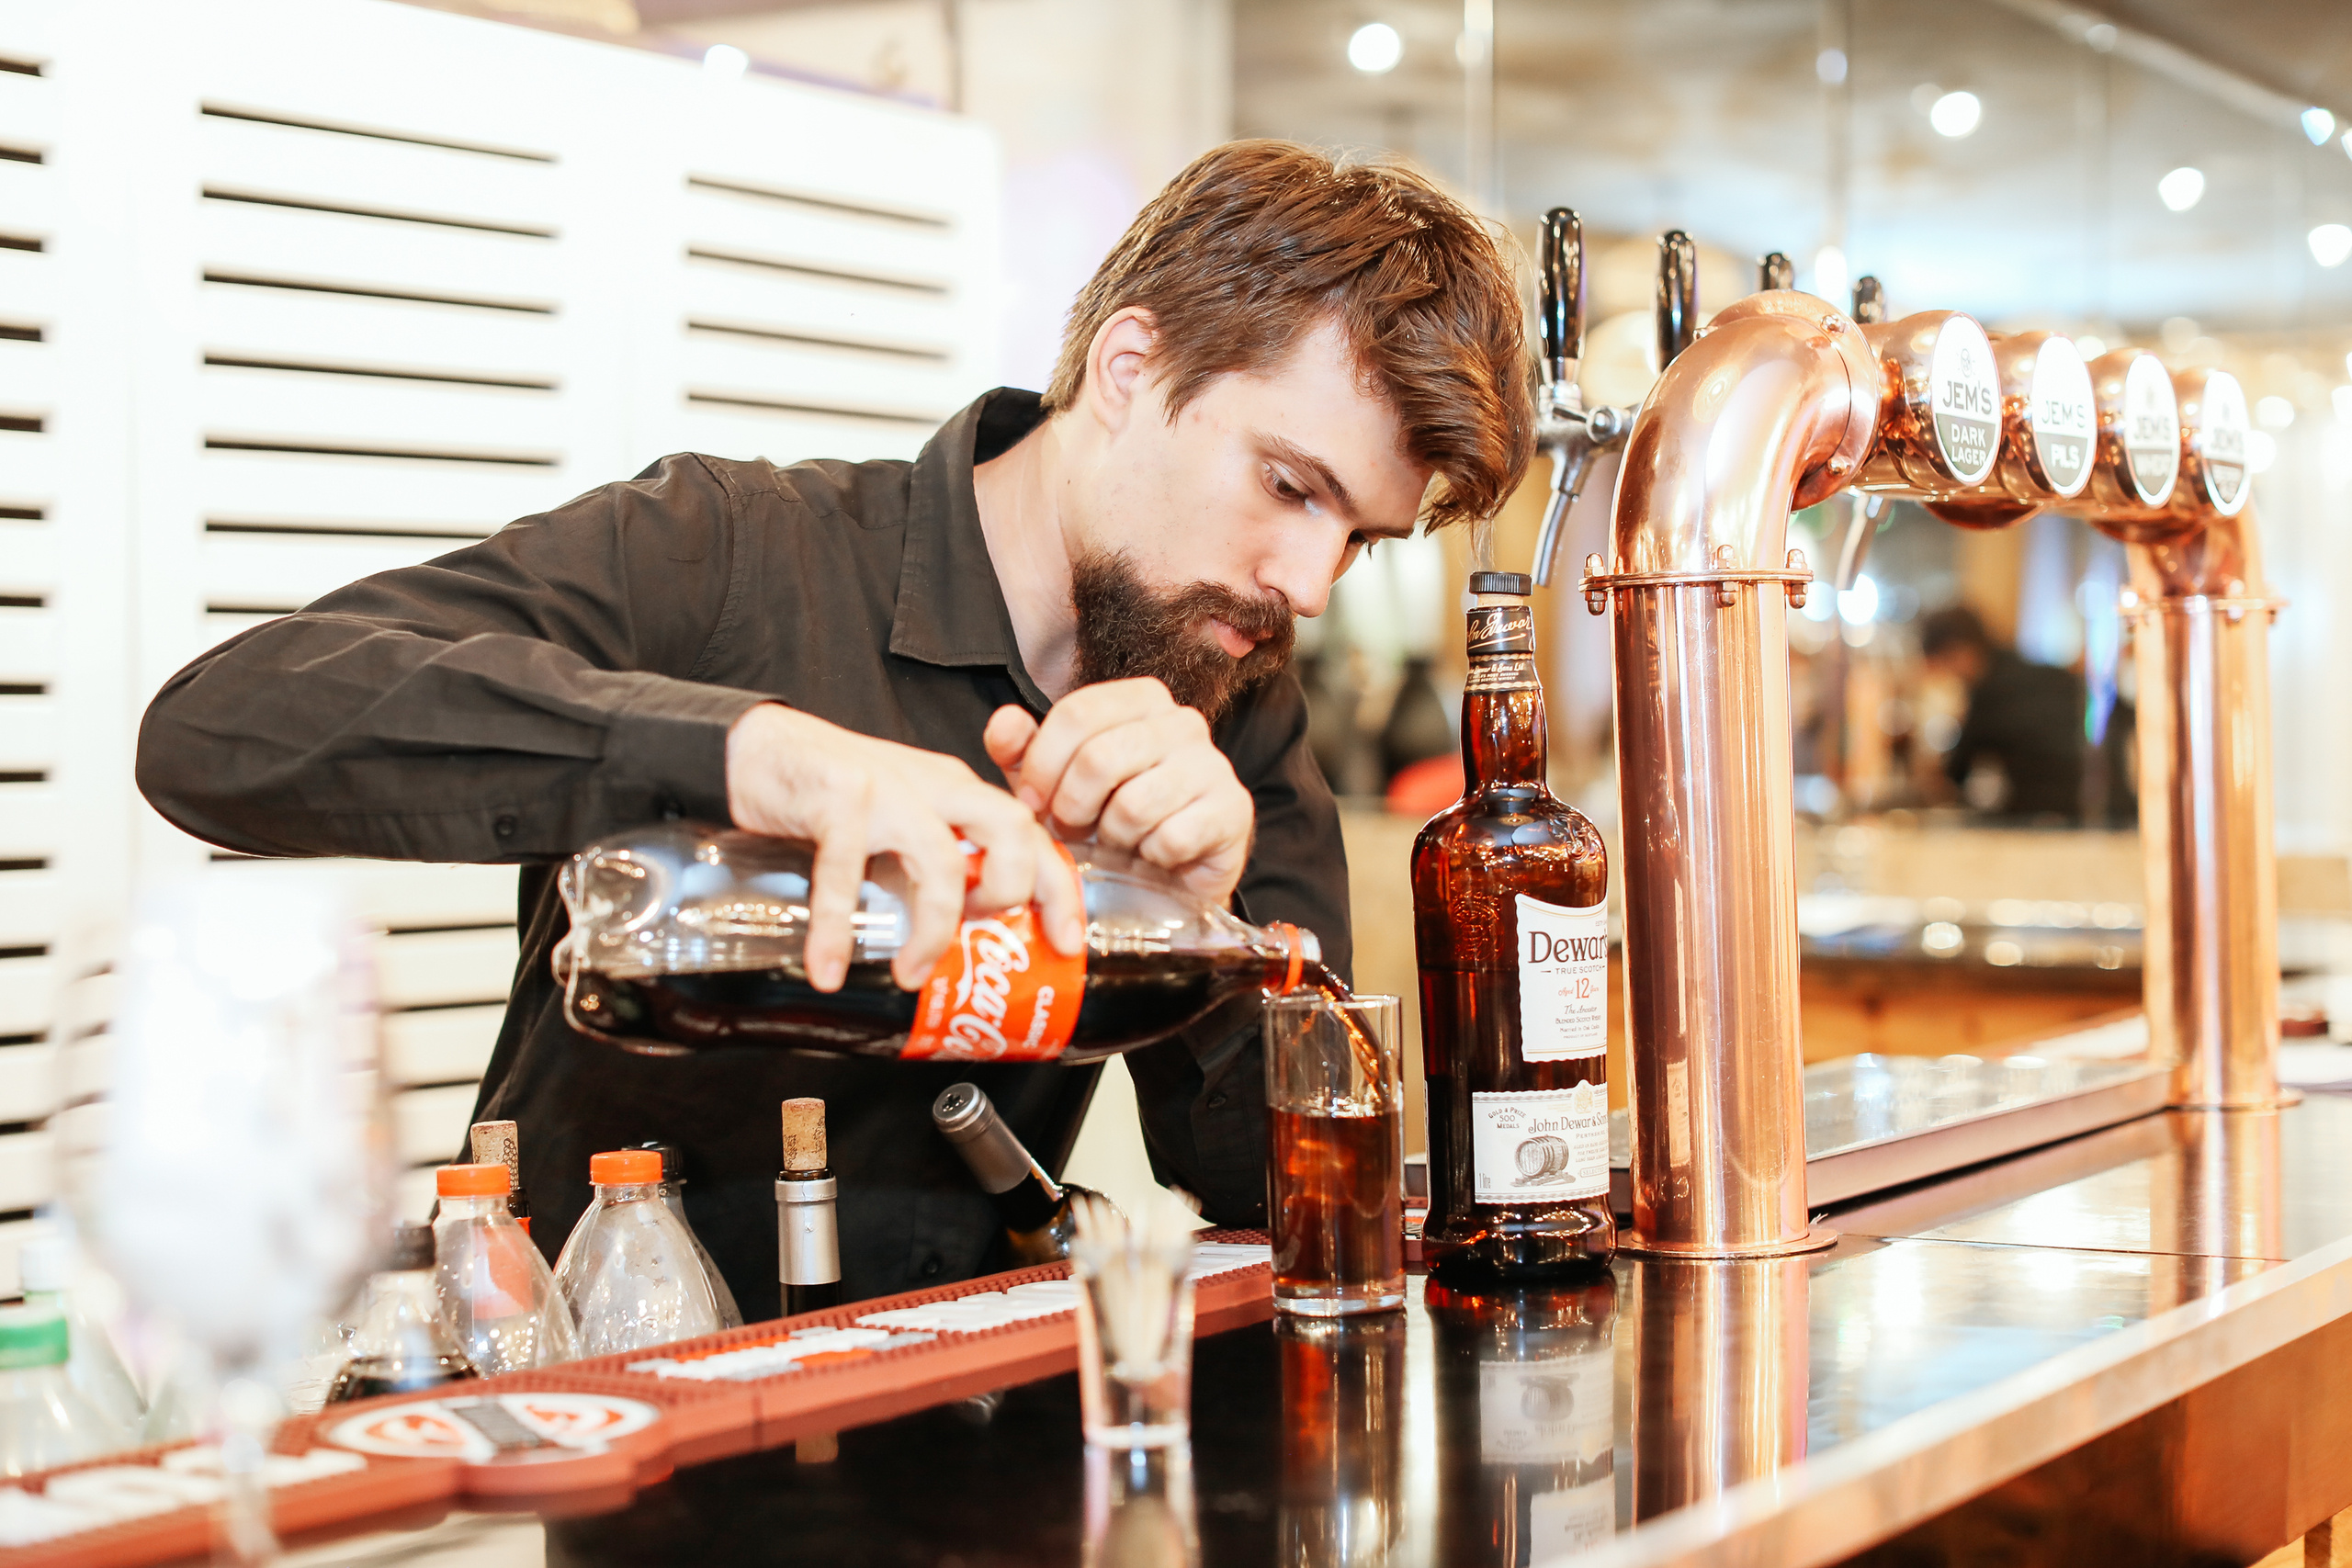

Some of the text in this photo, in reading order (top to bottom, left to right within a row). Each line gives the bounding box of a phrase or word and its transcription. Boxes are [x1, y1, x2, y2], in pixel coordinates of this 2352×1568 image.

[1942, 380, 1993, 414] JEM'S
[2041, 400, 2086, 429] JEMS
[1951, 423, 1986, 448] DARK
[1951, 446, 1986, 467] LAGER
[2051, 443, 2080, 469] PILS
[1578, 965, 1602, 974] SCOTCH
[1575, 977, 1590, 999] 12
[1487, 1109, 1503, 1119] GOLD
[1528, 1118, 1559, 1134] John
[1561, 1116, 1591, 1131] Dewar
[1591, 1117, 1597, 1127] &
